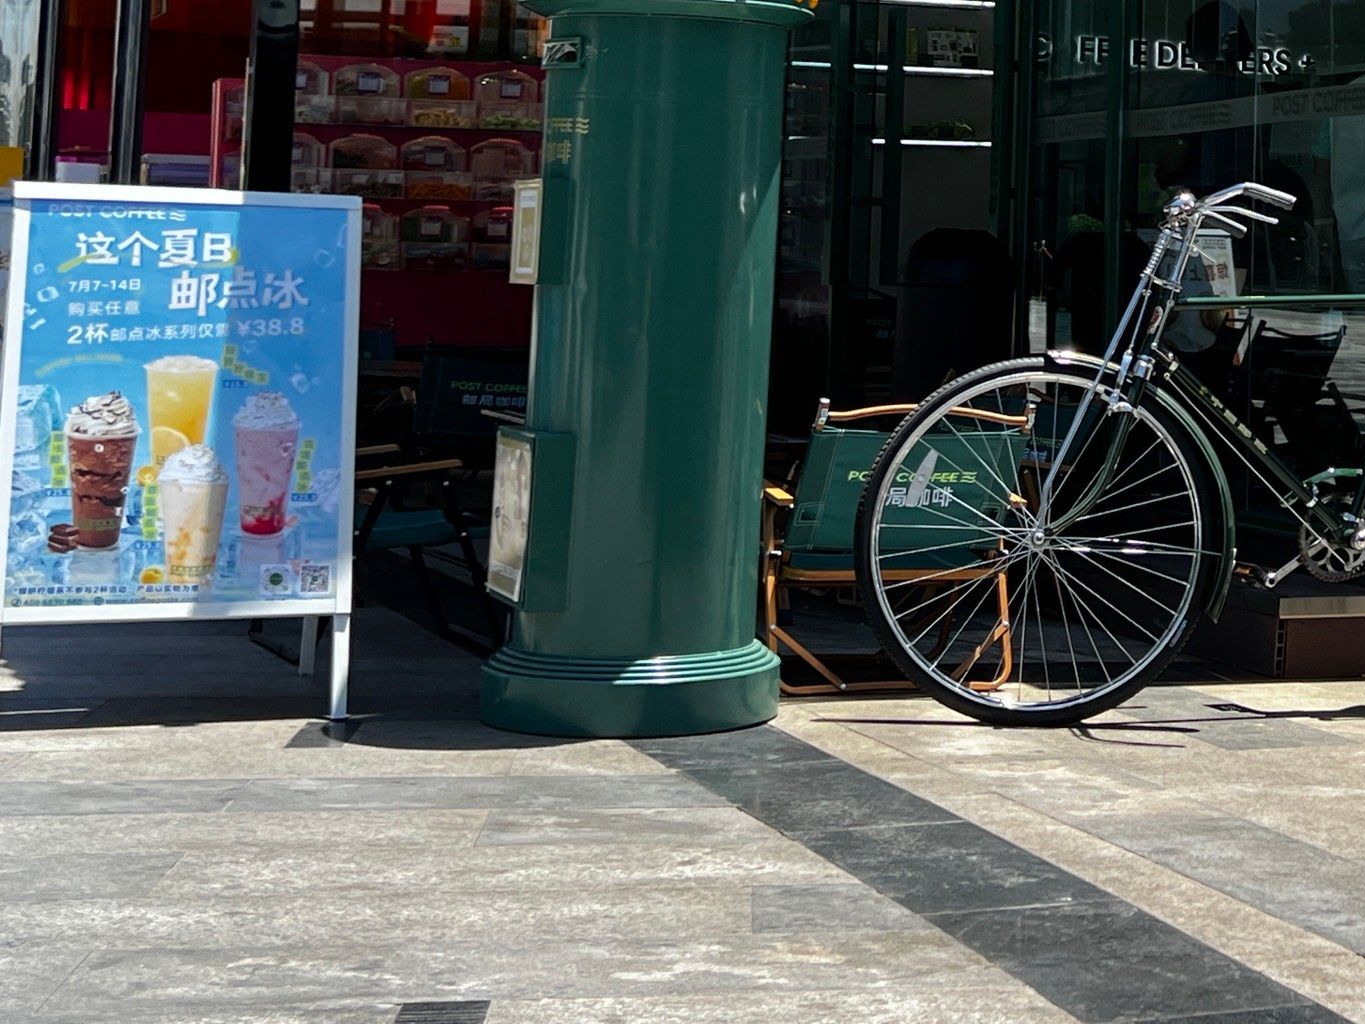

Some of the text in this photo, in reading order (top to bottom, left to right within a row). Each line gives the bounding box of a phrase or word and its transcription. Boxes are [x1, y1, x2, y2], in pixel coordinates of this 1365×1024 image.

[1272, 95, 1309, 116] POST
[48, 204, 167, 221] POST COFFEE
[75, 228, 233, 268] 这个夏日
[67, 278, 141, 293] 7月7-14日
[167, 270, 312, 317] 邮点冰
[67, 301, 140, 317] 购买任意
[237, 317, 304, 336] ¥38.8
